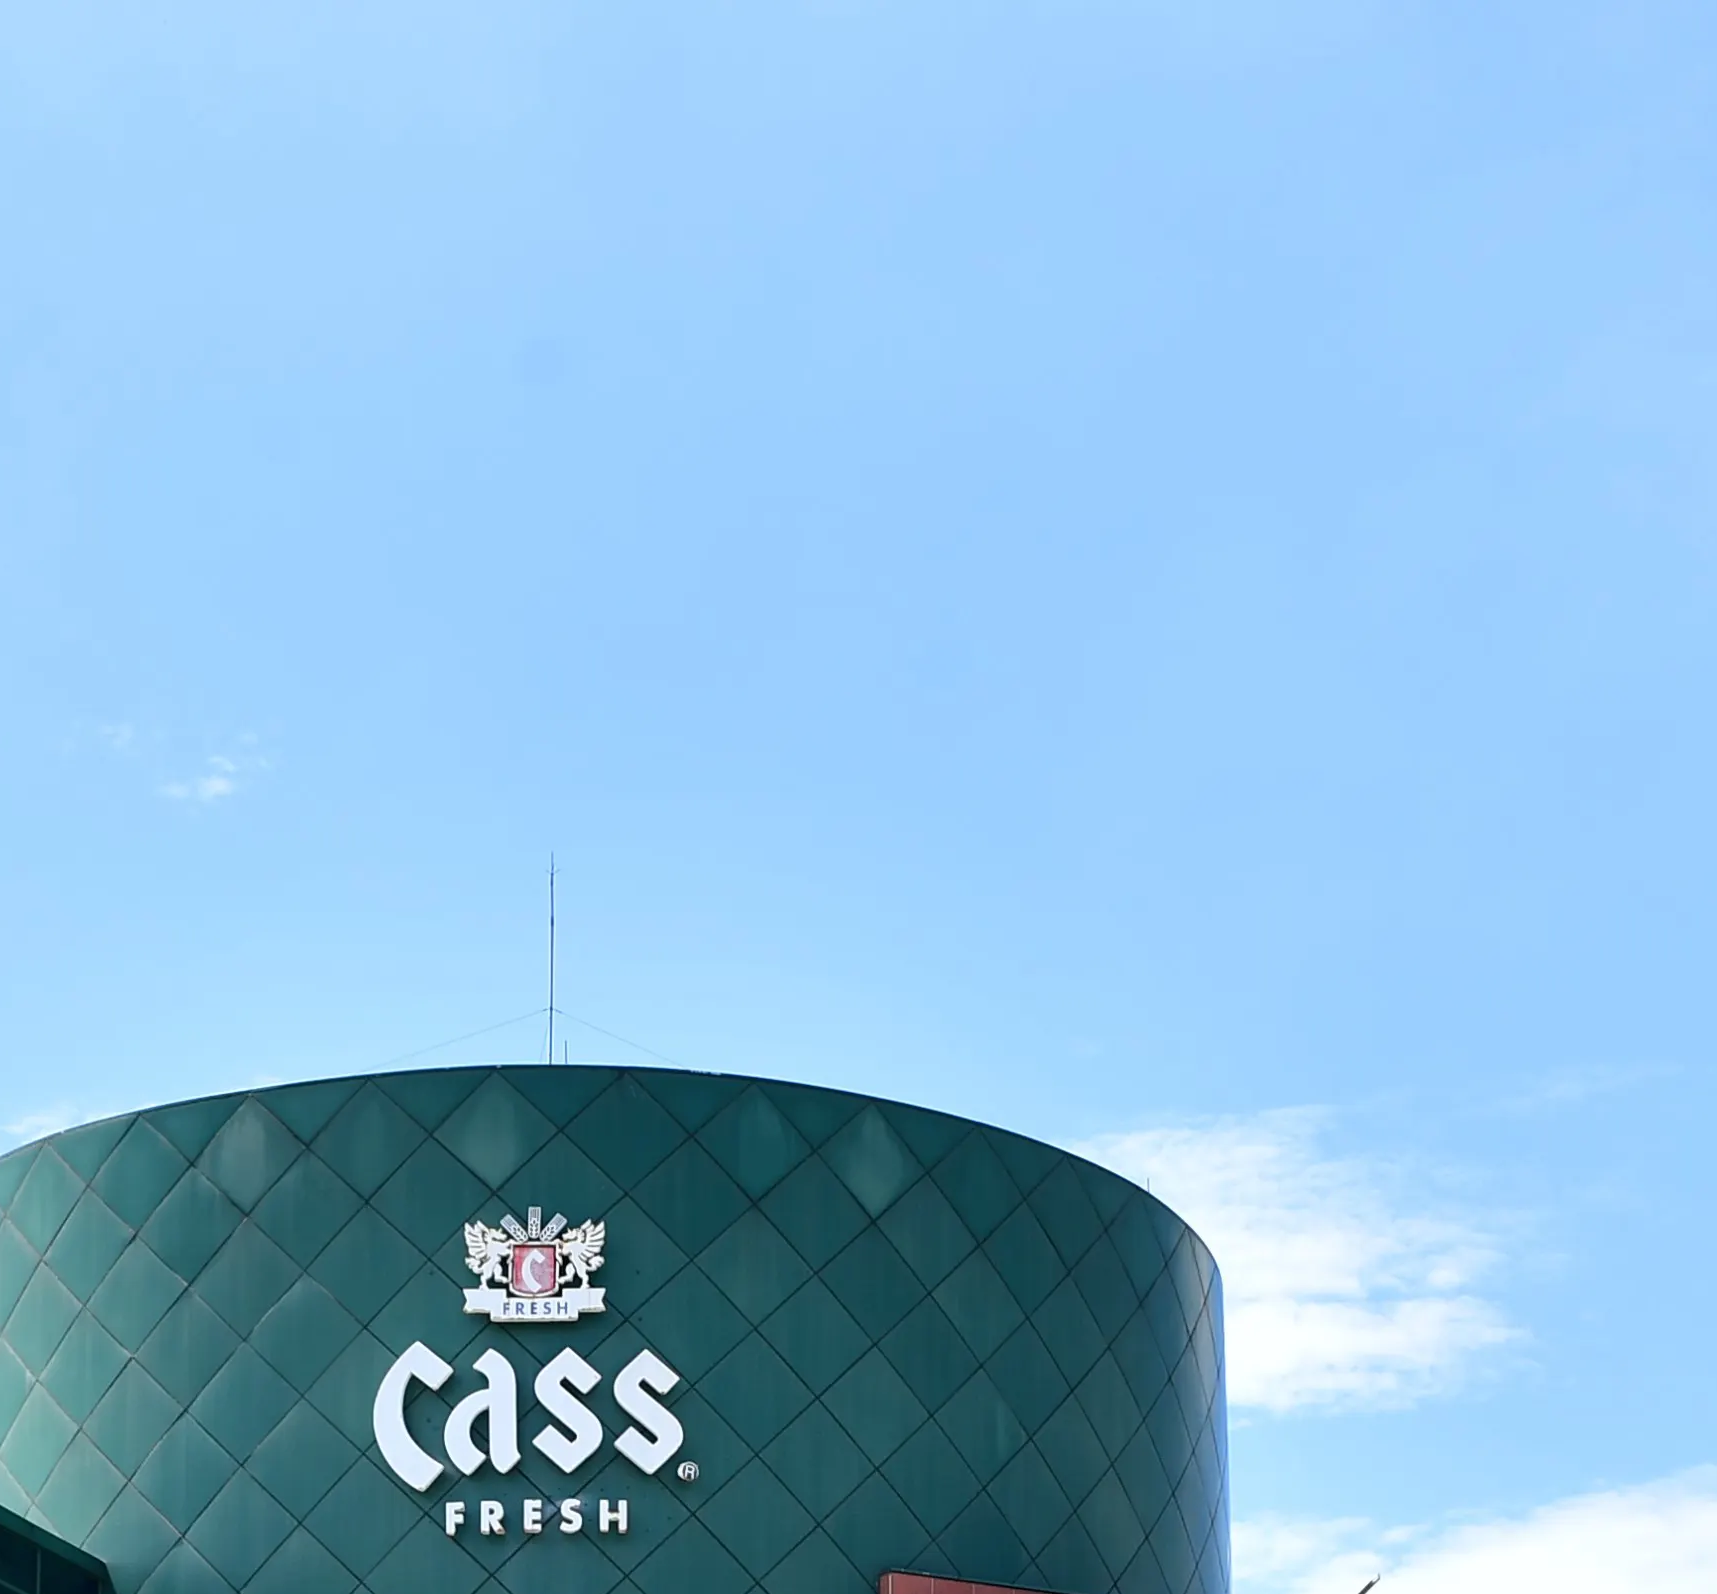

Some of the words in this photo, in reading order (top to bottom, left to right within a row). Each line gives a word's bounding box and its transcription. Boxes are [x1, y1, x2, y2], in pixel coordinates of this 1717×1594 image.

[502, 1301, 568, 1316] FRESH
[373, 1341, 684, 1492] Cass
[444, 1499, 629, 1535] FRESH
